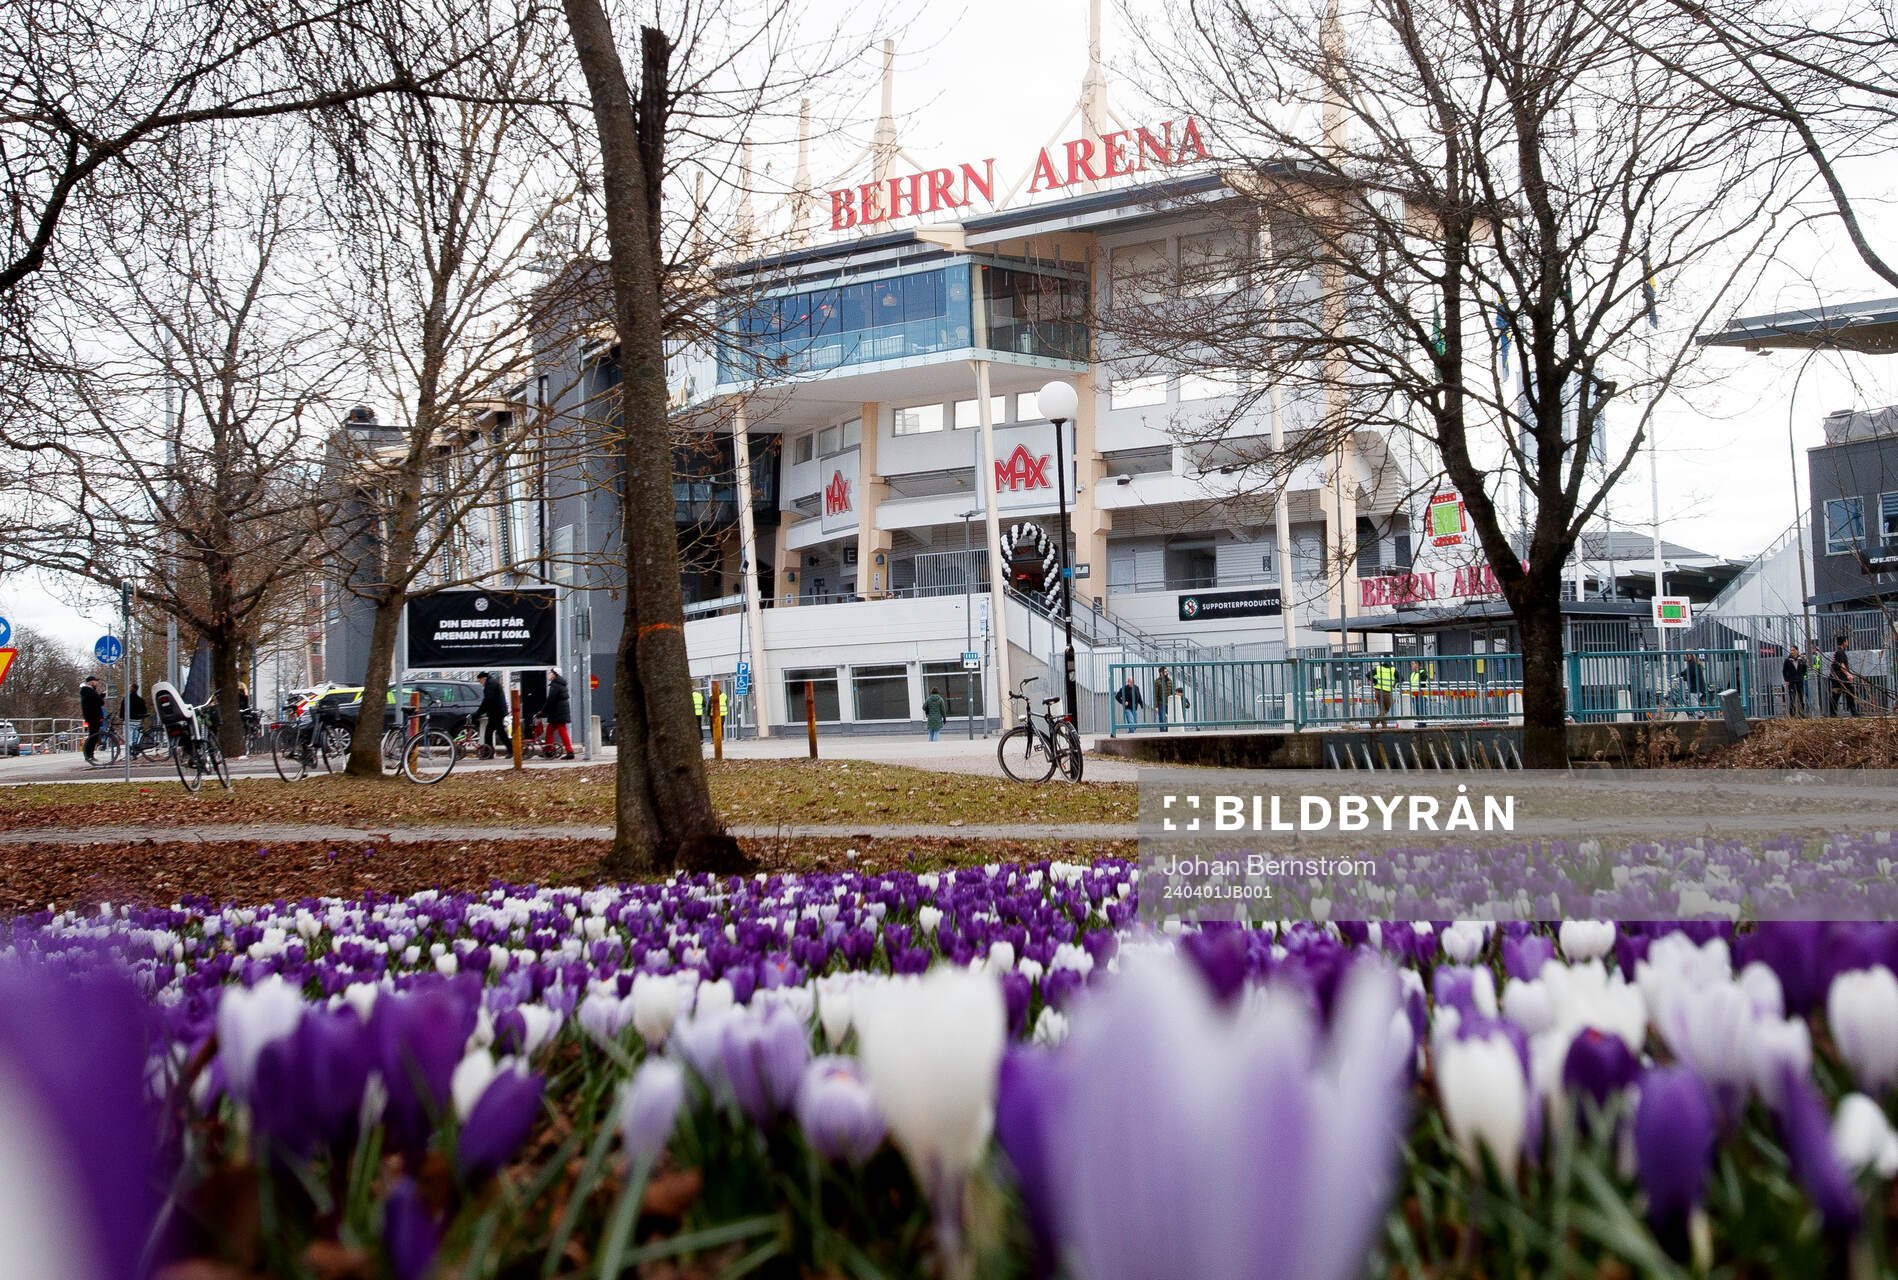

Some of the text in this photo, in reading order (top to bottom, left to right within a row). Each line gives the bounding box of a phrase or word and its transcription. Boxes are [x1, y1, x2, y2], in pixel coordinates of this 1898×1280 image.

[828, 116, 1211, 231] BEHRN ARENA
[994, 443, 1052, 493] MAX
[825, 470, 850, 517] MAX
[433, 629, 531, 641] ARENAN ATT KOKA
[439, 616, 524, 629] DIN ENERGI FÅR
[740, 663, 747, 675] P
